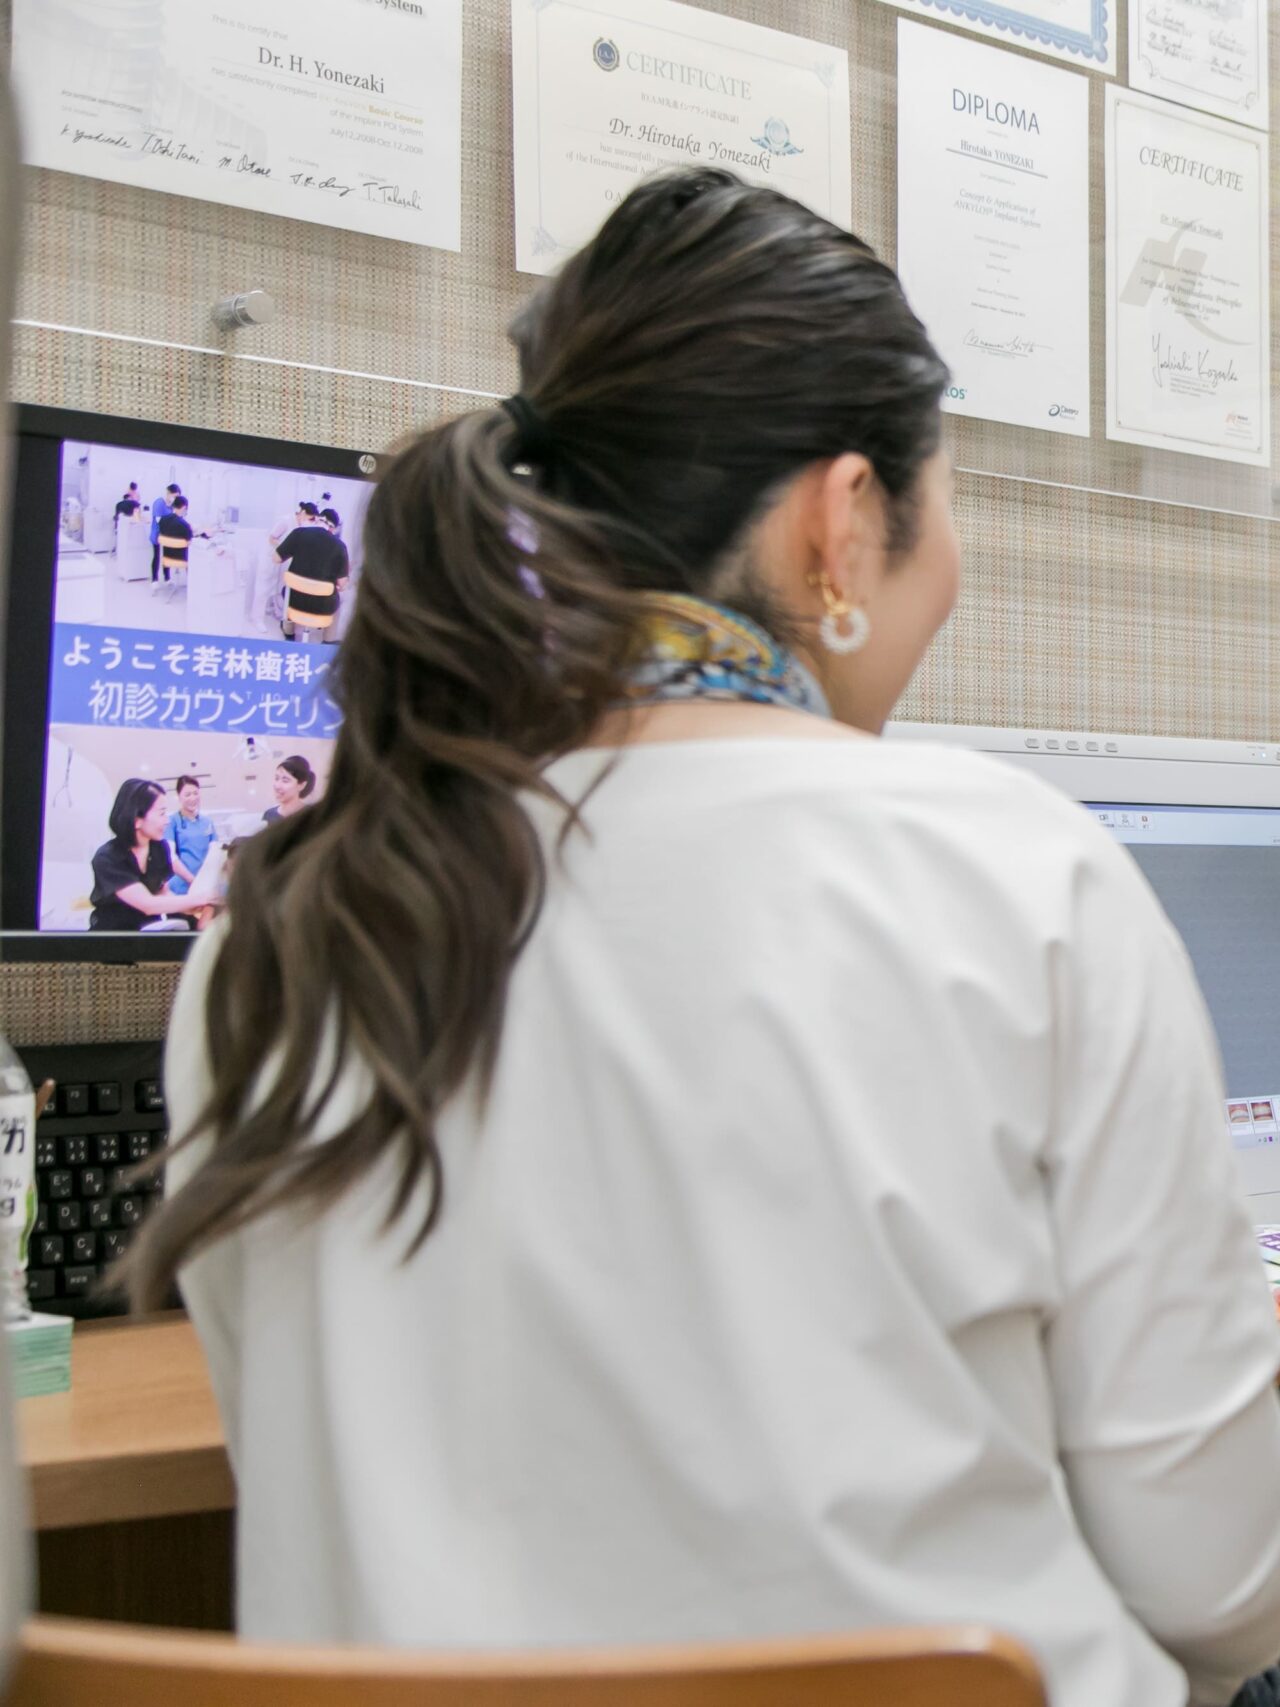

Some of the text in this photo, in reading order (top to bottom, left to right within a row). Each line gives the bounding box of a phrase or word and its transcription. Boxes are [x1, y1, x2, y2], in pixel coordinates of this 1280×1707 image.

[258, 46, 386, 94] Dr. H. Yonezaki
[625, 50, 752, 101] CERTIFICATE
[952, 88, 1041, 136] DIPLOMA
[609, 117, 772, 174] Dr. Hirotaka Yonezaki
[959, 139, 1034, 170] Hirotaka YONEZAKI
[1139, 145, 1244, 193] CERTIFICATE
